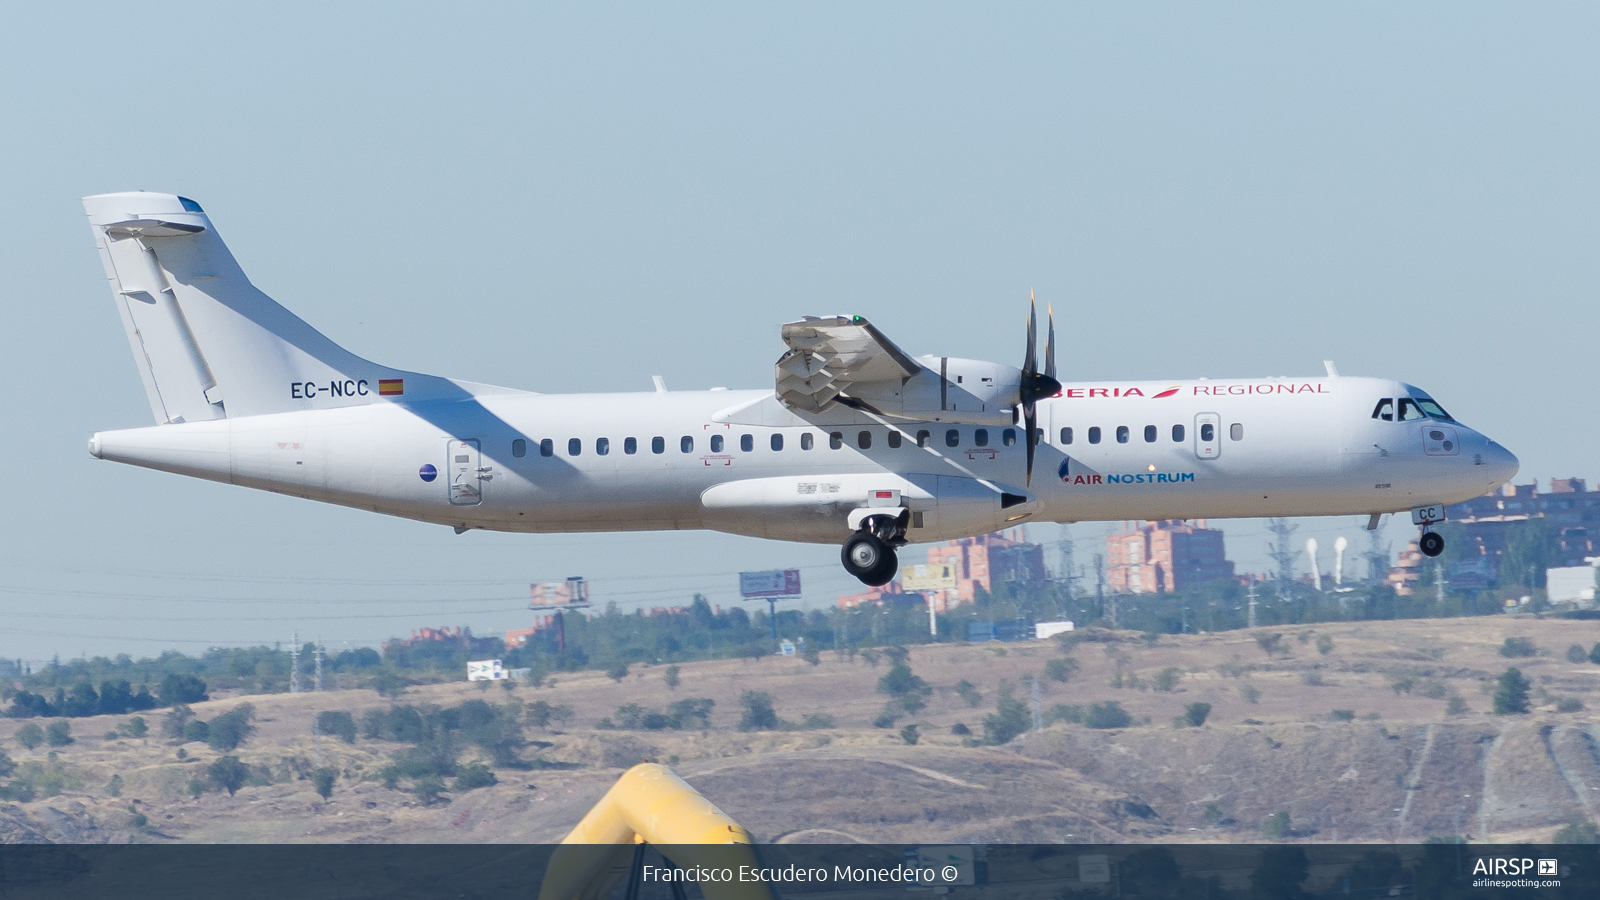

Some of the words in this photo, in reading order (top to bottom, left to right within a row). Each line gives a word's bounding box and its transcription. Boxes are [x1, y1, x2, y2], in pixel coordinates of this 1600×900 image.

[291, 379, 369, 399] EC-NCC
[1193, 383, 1331, 397] REGIONAL
[1073, 474, 1103, 485] AIR
[1107, 472, 1195, 484] NOSTRUM
[1419, 507, 1436, 520] CC
